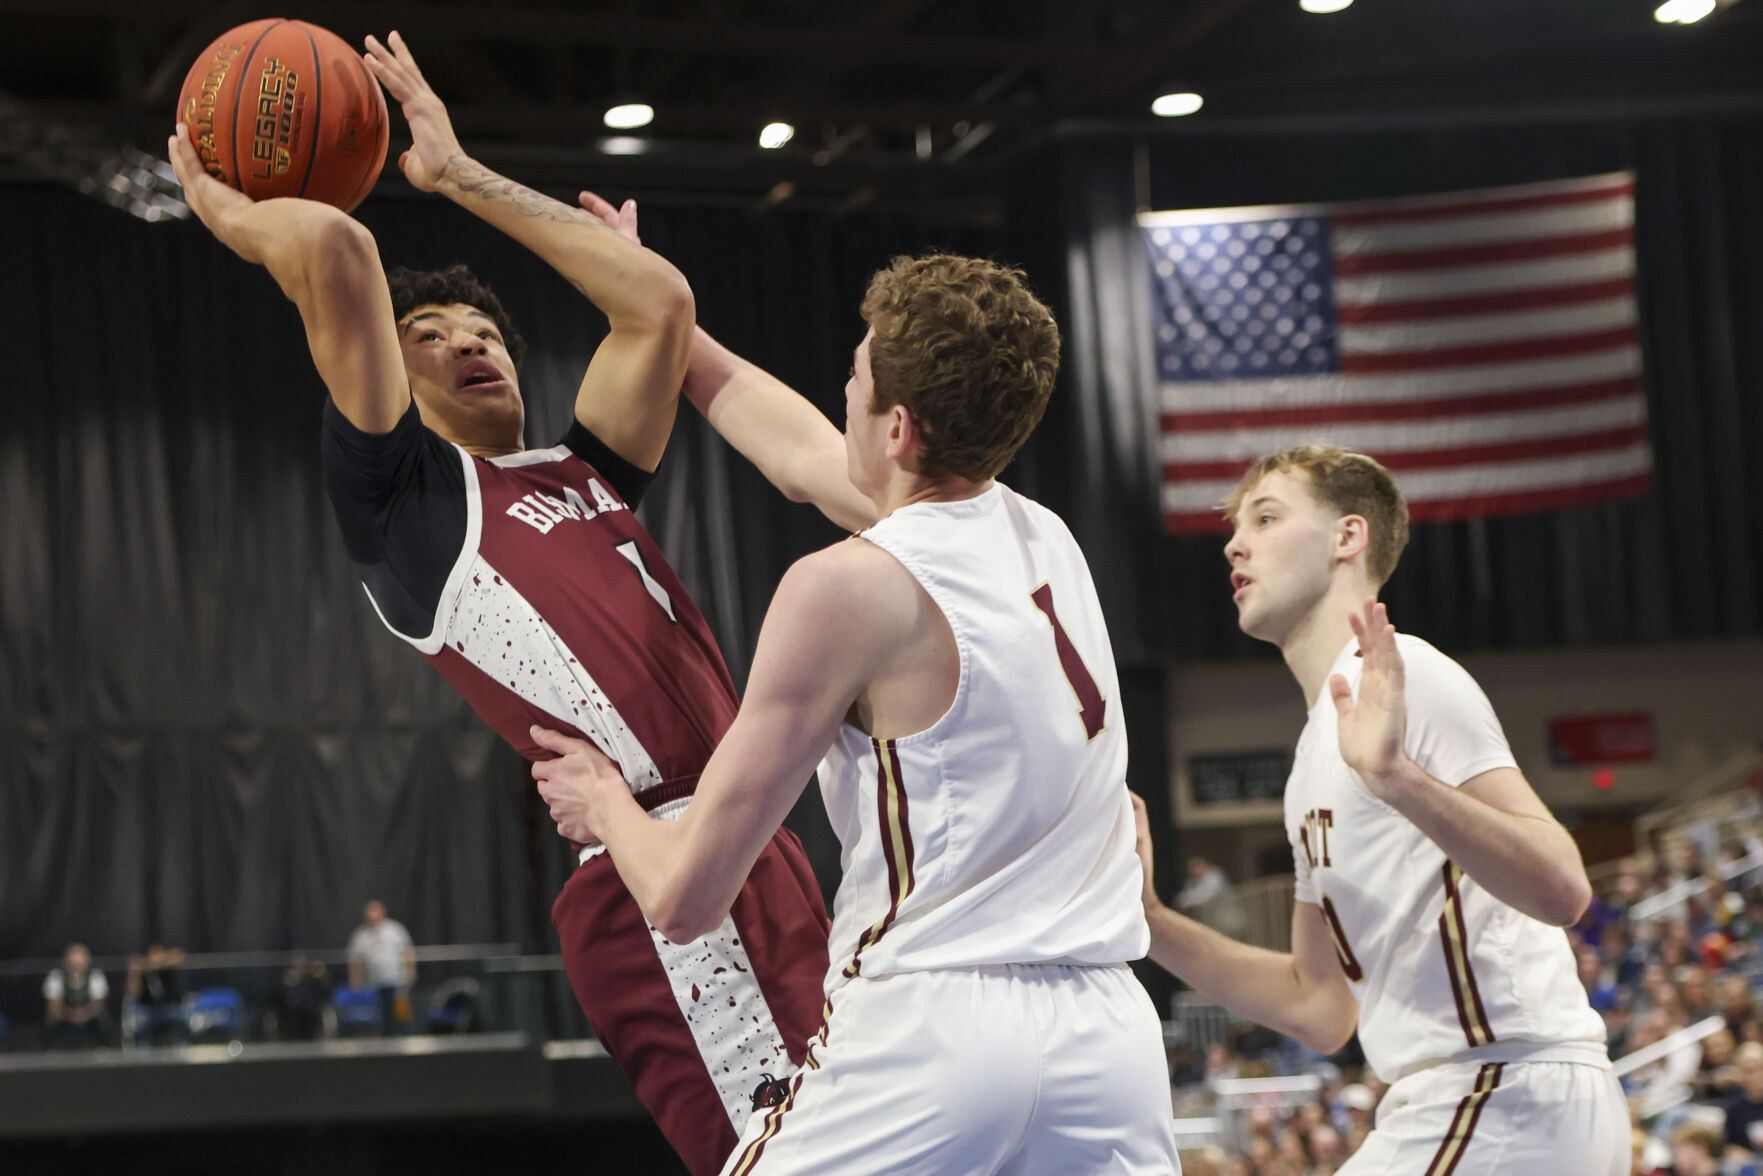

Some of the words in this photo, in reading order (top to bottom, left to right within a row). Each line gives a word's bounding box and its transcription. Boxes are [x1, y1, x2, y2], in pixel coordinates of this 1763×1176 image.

[252, 57, 285, 180] LEGACY
[278, 70, 298, 145] 1000
[613, 537, 678, 624] 1
[1028, 580, 1109, 744] 1
